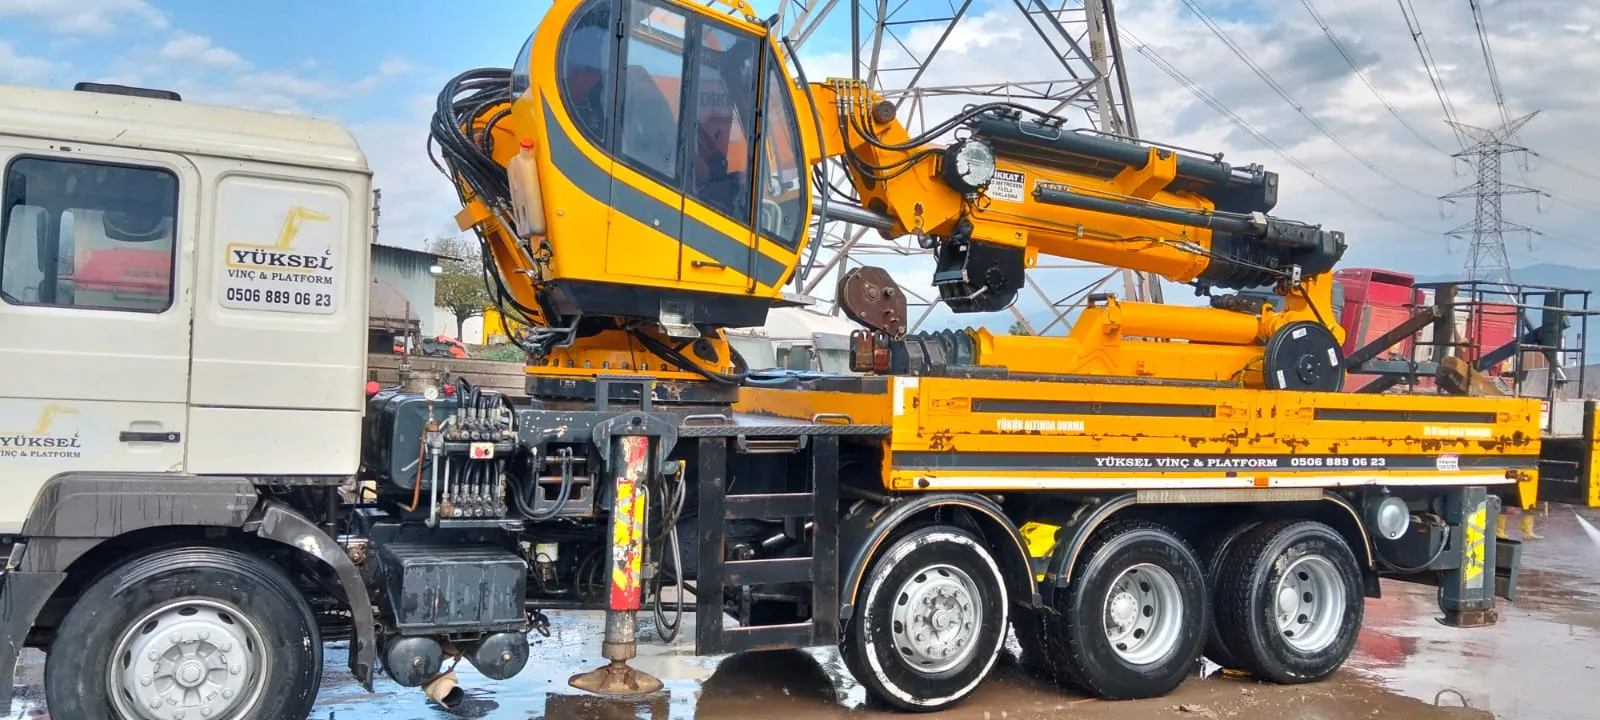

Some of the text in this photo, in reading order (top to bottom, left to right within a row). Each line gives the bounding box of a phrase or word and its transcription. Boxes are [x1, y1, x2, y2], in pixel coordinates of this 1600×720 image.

[233, 249, 333, 270] YÜKSEL
[228, 268, 333, 285] VİNÇ & PLATFORM
[227, 287, 331, 307] 0506 889 06 23
[0, 434, 81, 448] YÜKSEL
[0, 450, 17, 458] İNÇ
[1095, 456, 1386, 468] YÜKSEL VİNÇ & PLATFORM 0506 889 06 23
